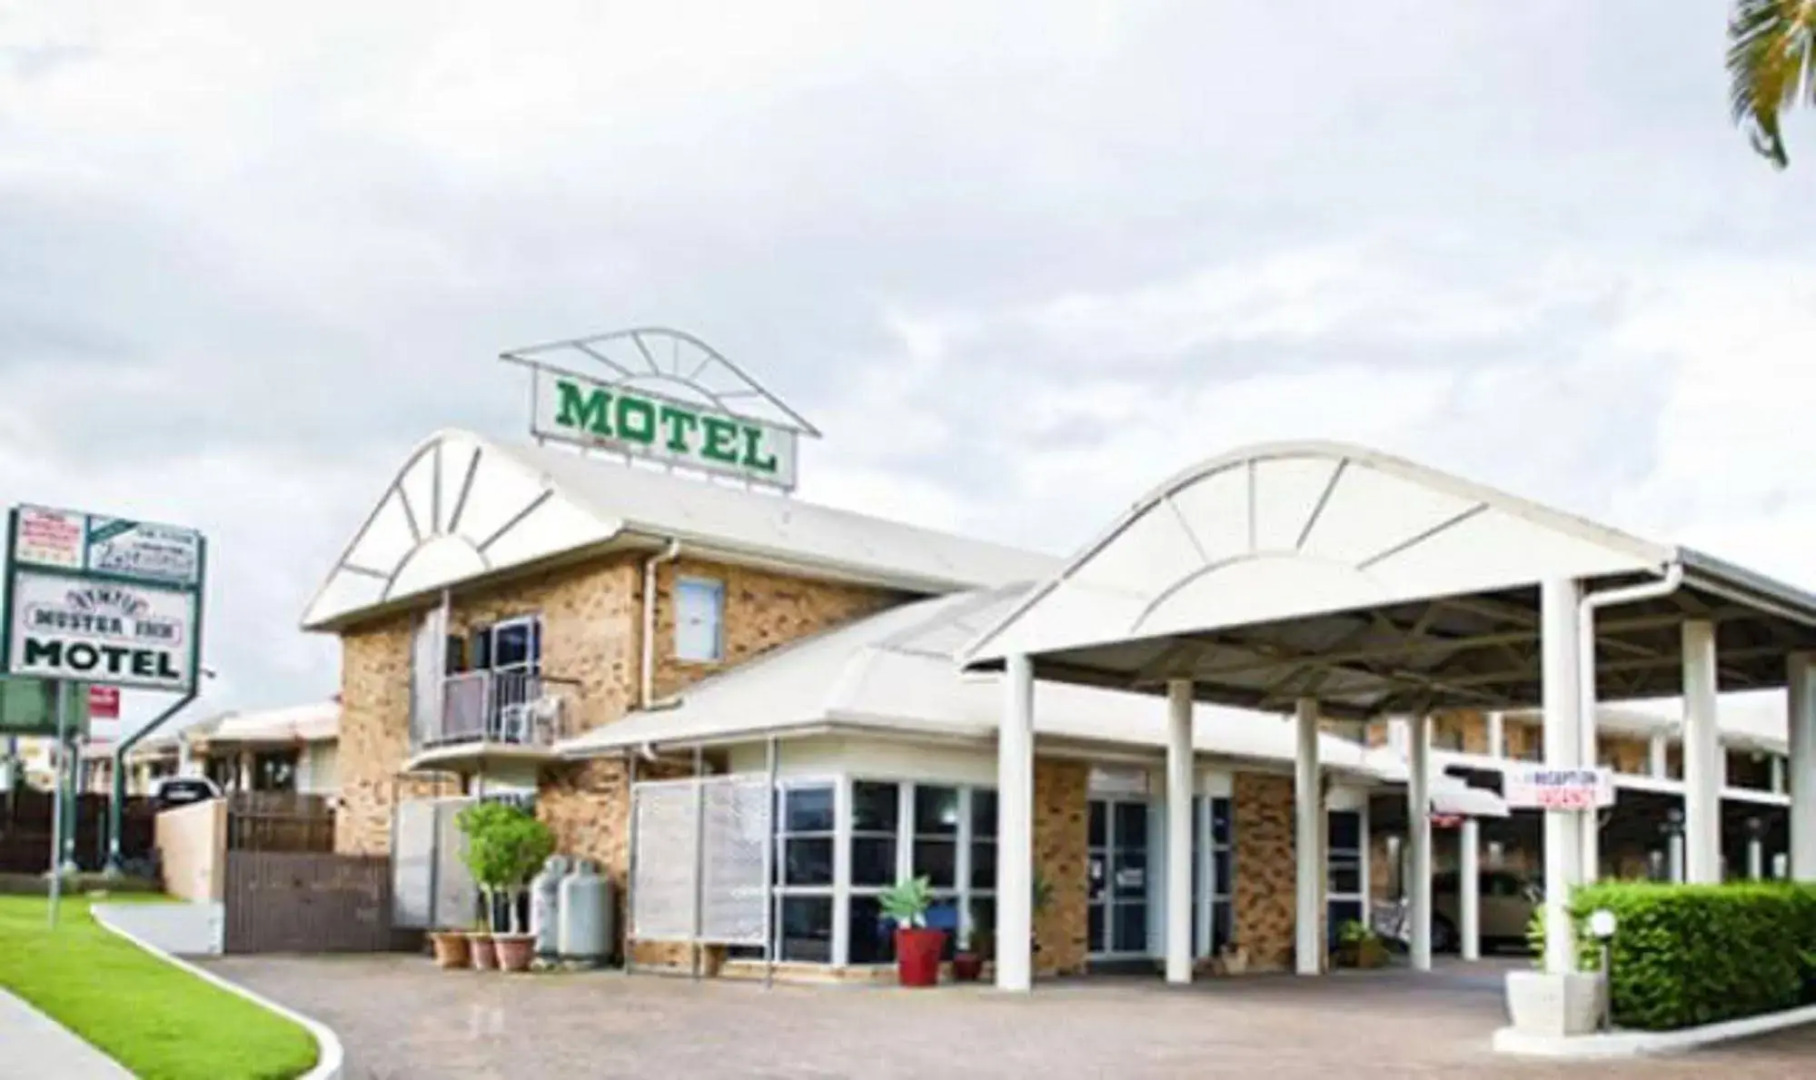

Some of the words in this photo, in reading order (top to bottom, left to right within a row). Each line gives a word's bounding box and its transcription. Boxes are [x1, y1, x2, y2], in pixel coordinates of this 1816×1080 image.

[556, 380, 777, 472] MOTEL
[35, 609, 123, 635] MUSTER
[24, 638, 179, 679] MOTEL
